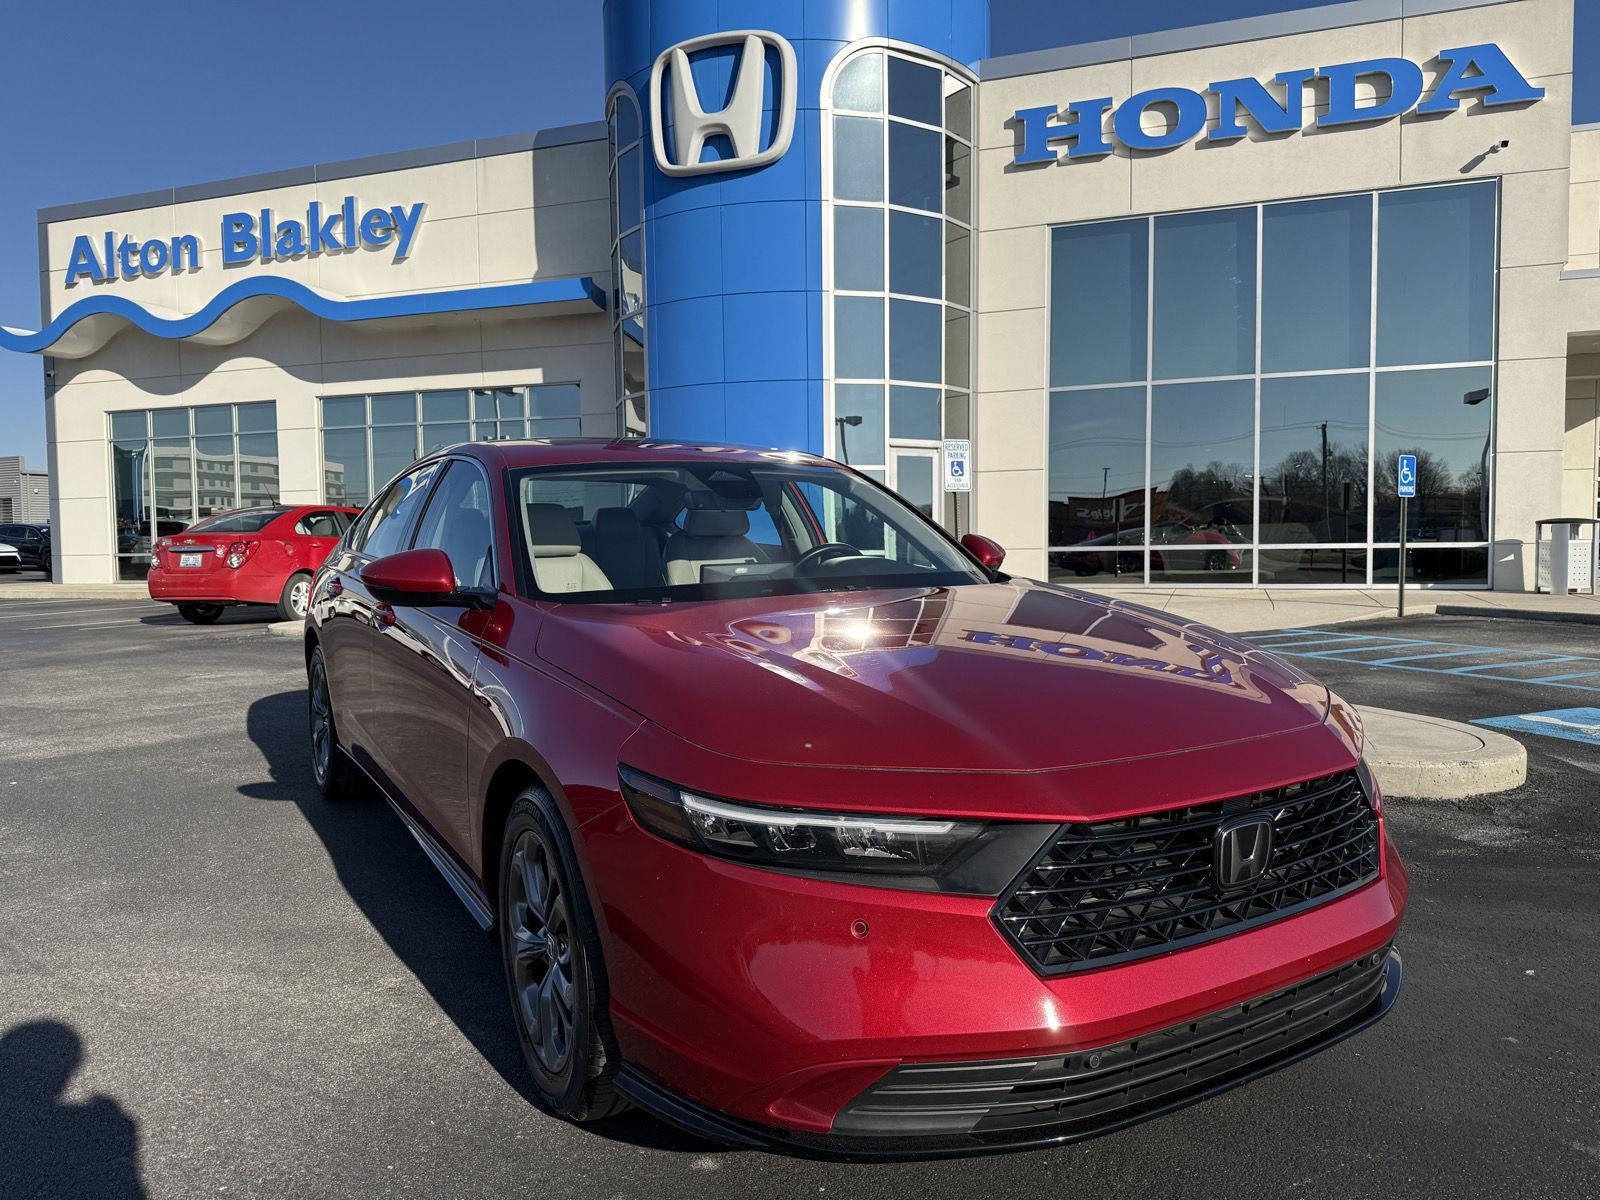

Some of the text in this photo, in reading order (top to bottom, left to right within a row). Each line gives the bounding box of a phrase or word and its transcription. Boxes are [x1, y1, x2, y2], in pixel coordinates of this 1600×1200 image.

[1014, 43, 1545, 165] HONDA
[65, 196, 425, 284] Alton Blakley
[945, 443, 968, 451] RESERVED
